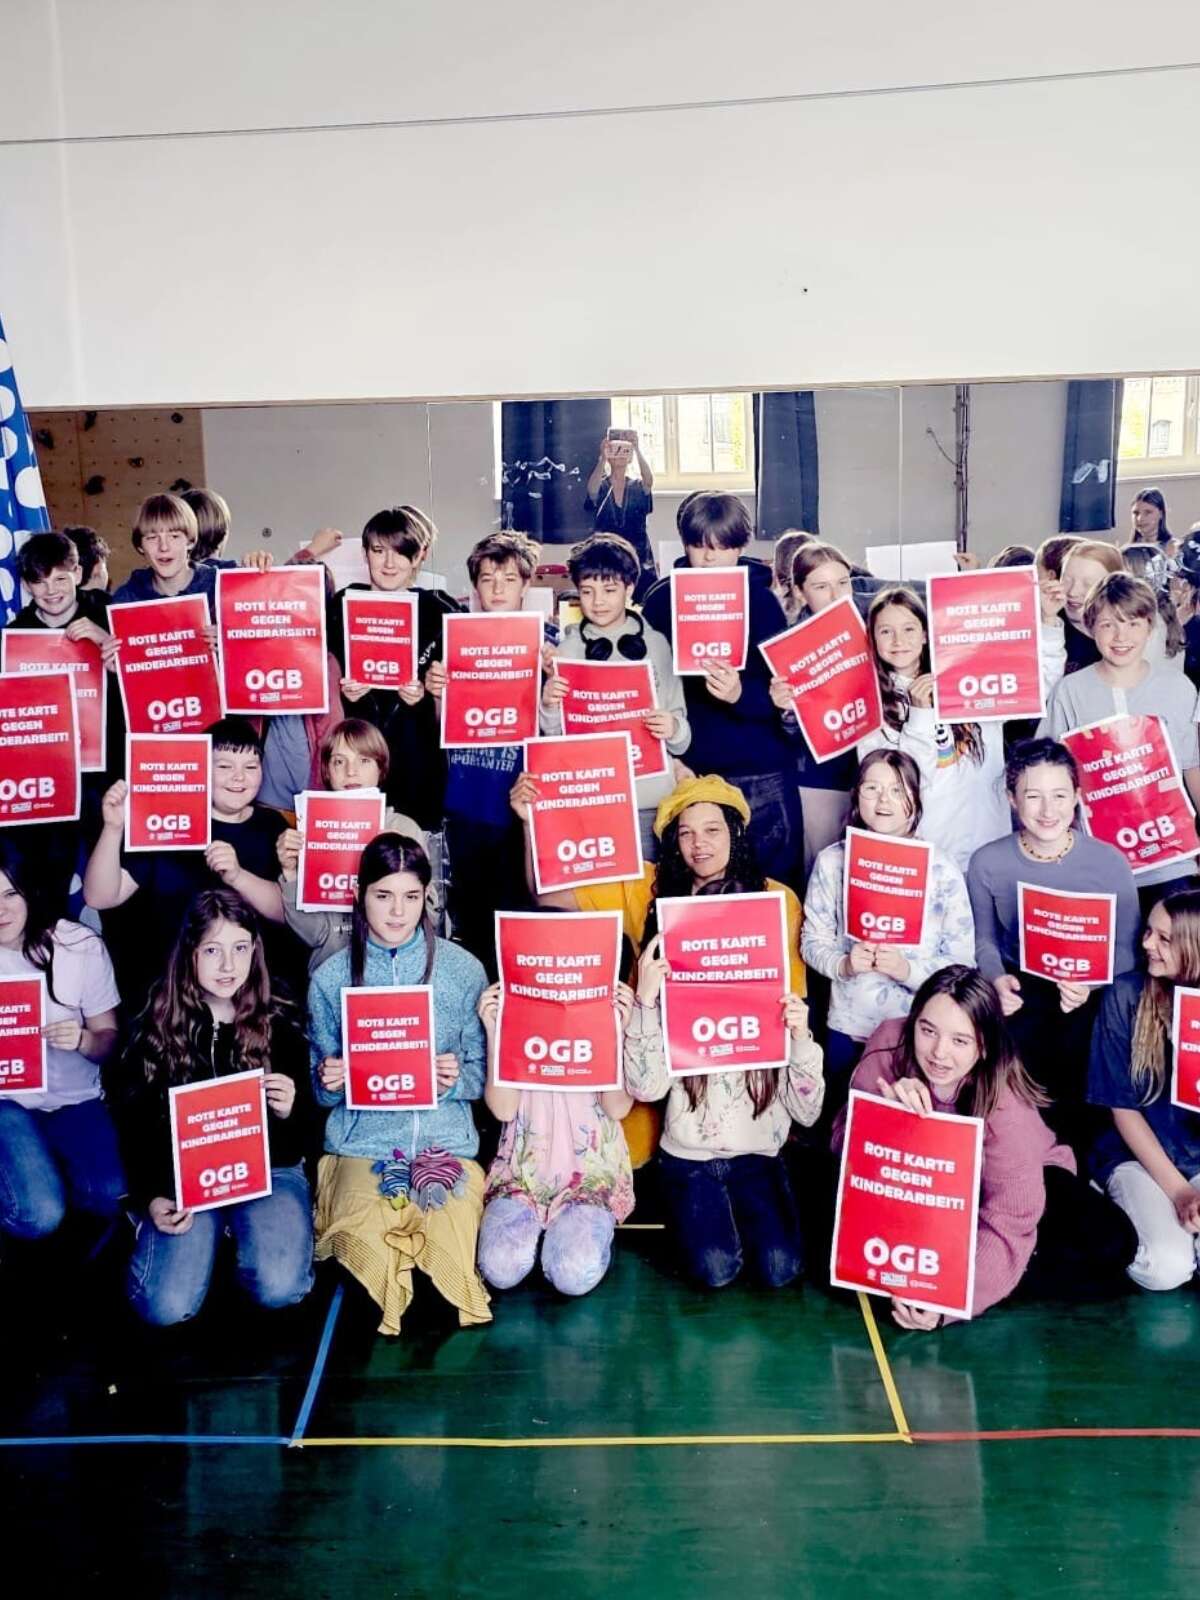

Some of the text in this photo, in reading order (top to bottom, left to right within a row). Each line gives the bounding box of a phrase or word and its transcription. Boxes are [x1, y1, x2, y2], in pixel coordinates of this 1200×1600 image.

[234, 601, 306, 611] ROTE KARTE
[945, 602, 1021, 616] ROTE KARTE
[251, 615, 291, 624] GEGEN
[964, 618, 1006, 628] GEGEN
[128, 629, 196, 646] ROTE KARTE
[227, 628, 316, 639] KINDERARBEIT!
[938, 629, 1031, 644] KINDERARBEIT!
[145, 644, 183, 657] GEGEN
[461, 646, 527, 656] ROTE KARTE
[790, 631, 851, 673] ROTE KARTE
[125, 654, 208, 673] KINDERARBEIT!
[475, 659, 512, 668] GEGEN
[810, 650, 842, 675] GEGEN
[452, 669, 532, 680] KINDERARBEIT!
[572, 690, 639, 700] ROTE KARTE
[0, 705, 58, 719] TE KARTE
[587, 702, 625, 712] GEGEN
[1, 720, 43, 732] GEGEN
[0, 732, 68, 746] DERARBEIT!
[1082, 743, 1153, 773] ROTE KARTE
[140, 762, 198, 771] ROTE KARTE
[1102, 764, 1143, 782] GEGEN
[152, 773, 185, 782] GEGEN
[542, 768, 615, 782] ROTE KARTE
[134, 784, 205, 792] KINDERARBEIT!
[559, 782, 600, 794] GEGEN
[1086, 767, 1169, 802] KINDERARBEIT!
[535, 794, 626, 810] KINDERARBEIT!
[315, 820, 371, 829] ROTE KARTE
[327, 832, 358, 840] GEGEN
[858, 858, 917, 876] ROTE KARTE
[869, 872, 903, 885] GEGEN
[1033, 908, 1100, 924] ROTE KARTE
[1047, 921, 1084, 932] GEGEN
[682, 935, 766, 952] ROTE KARTE
[517, 954, 601, 967] ROTE KARTE
[700, 954, 748, 966] GEGEN
[536, 972, 582, 984] GEGEN
[671, 968, 778, 981] KINDERARBEIT!
[510, 983, 608, 1001] KINDERARBEIT!
[357, 1016, 420, 1028] ROTE KARTE
[0, 1026, 39, 1037] ARBEIT!
[371, 1030, 406, 1039] GEGEN
[351, 1040, 428, 1052] KINDERARBEIT!
[187, 1103, 252, 1124] ROTE KARTE
[202, 1118, 238, 1132] GEGEN
[181, 1125, 261, 1150] KINDERARBEIT!
[864, 1141, 955, 1173] ROTE KARTE
[880, 1166, 932, 1188] GEGEN
[850, 1174, 964, 1210] KINDERARBEIT!
